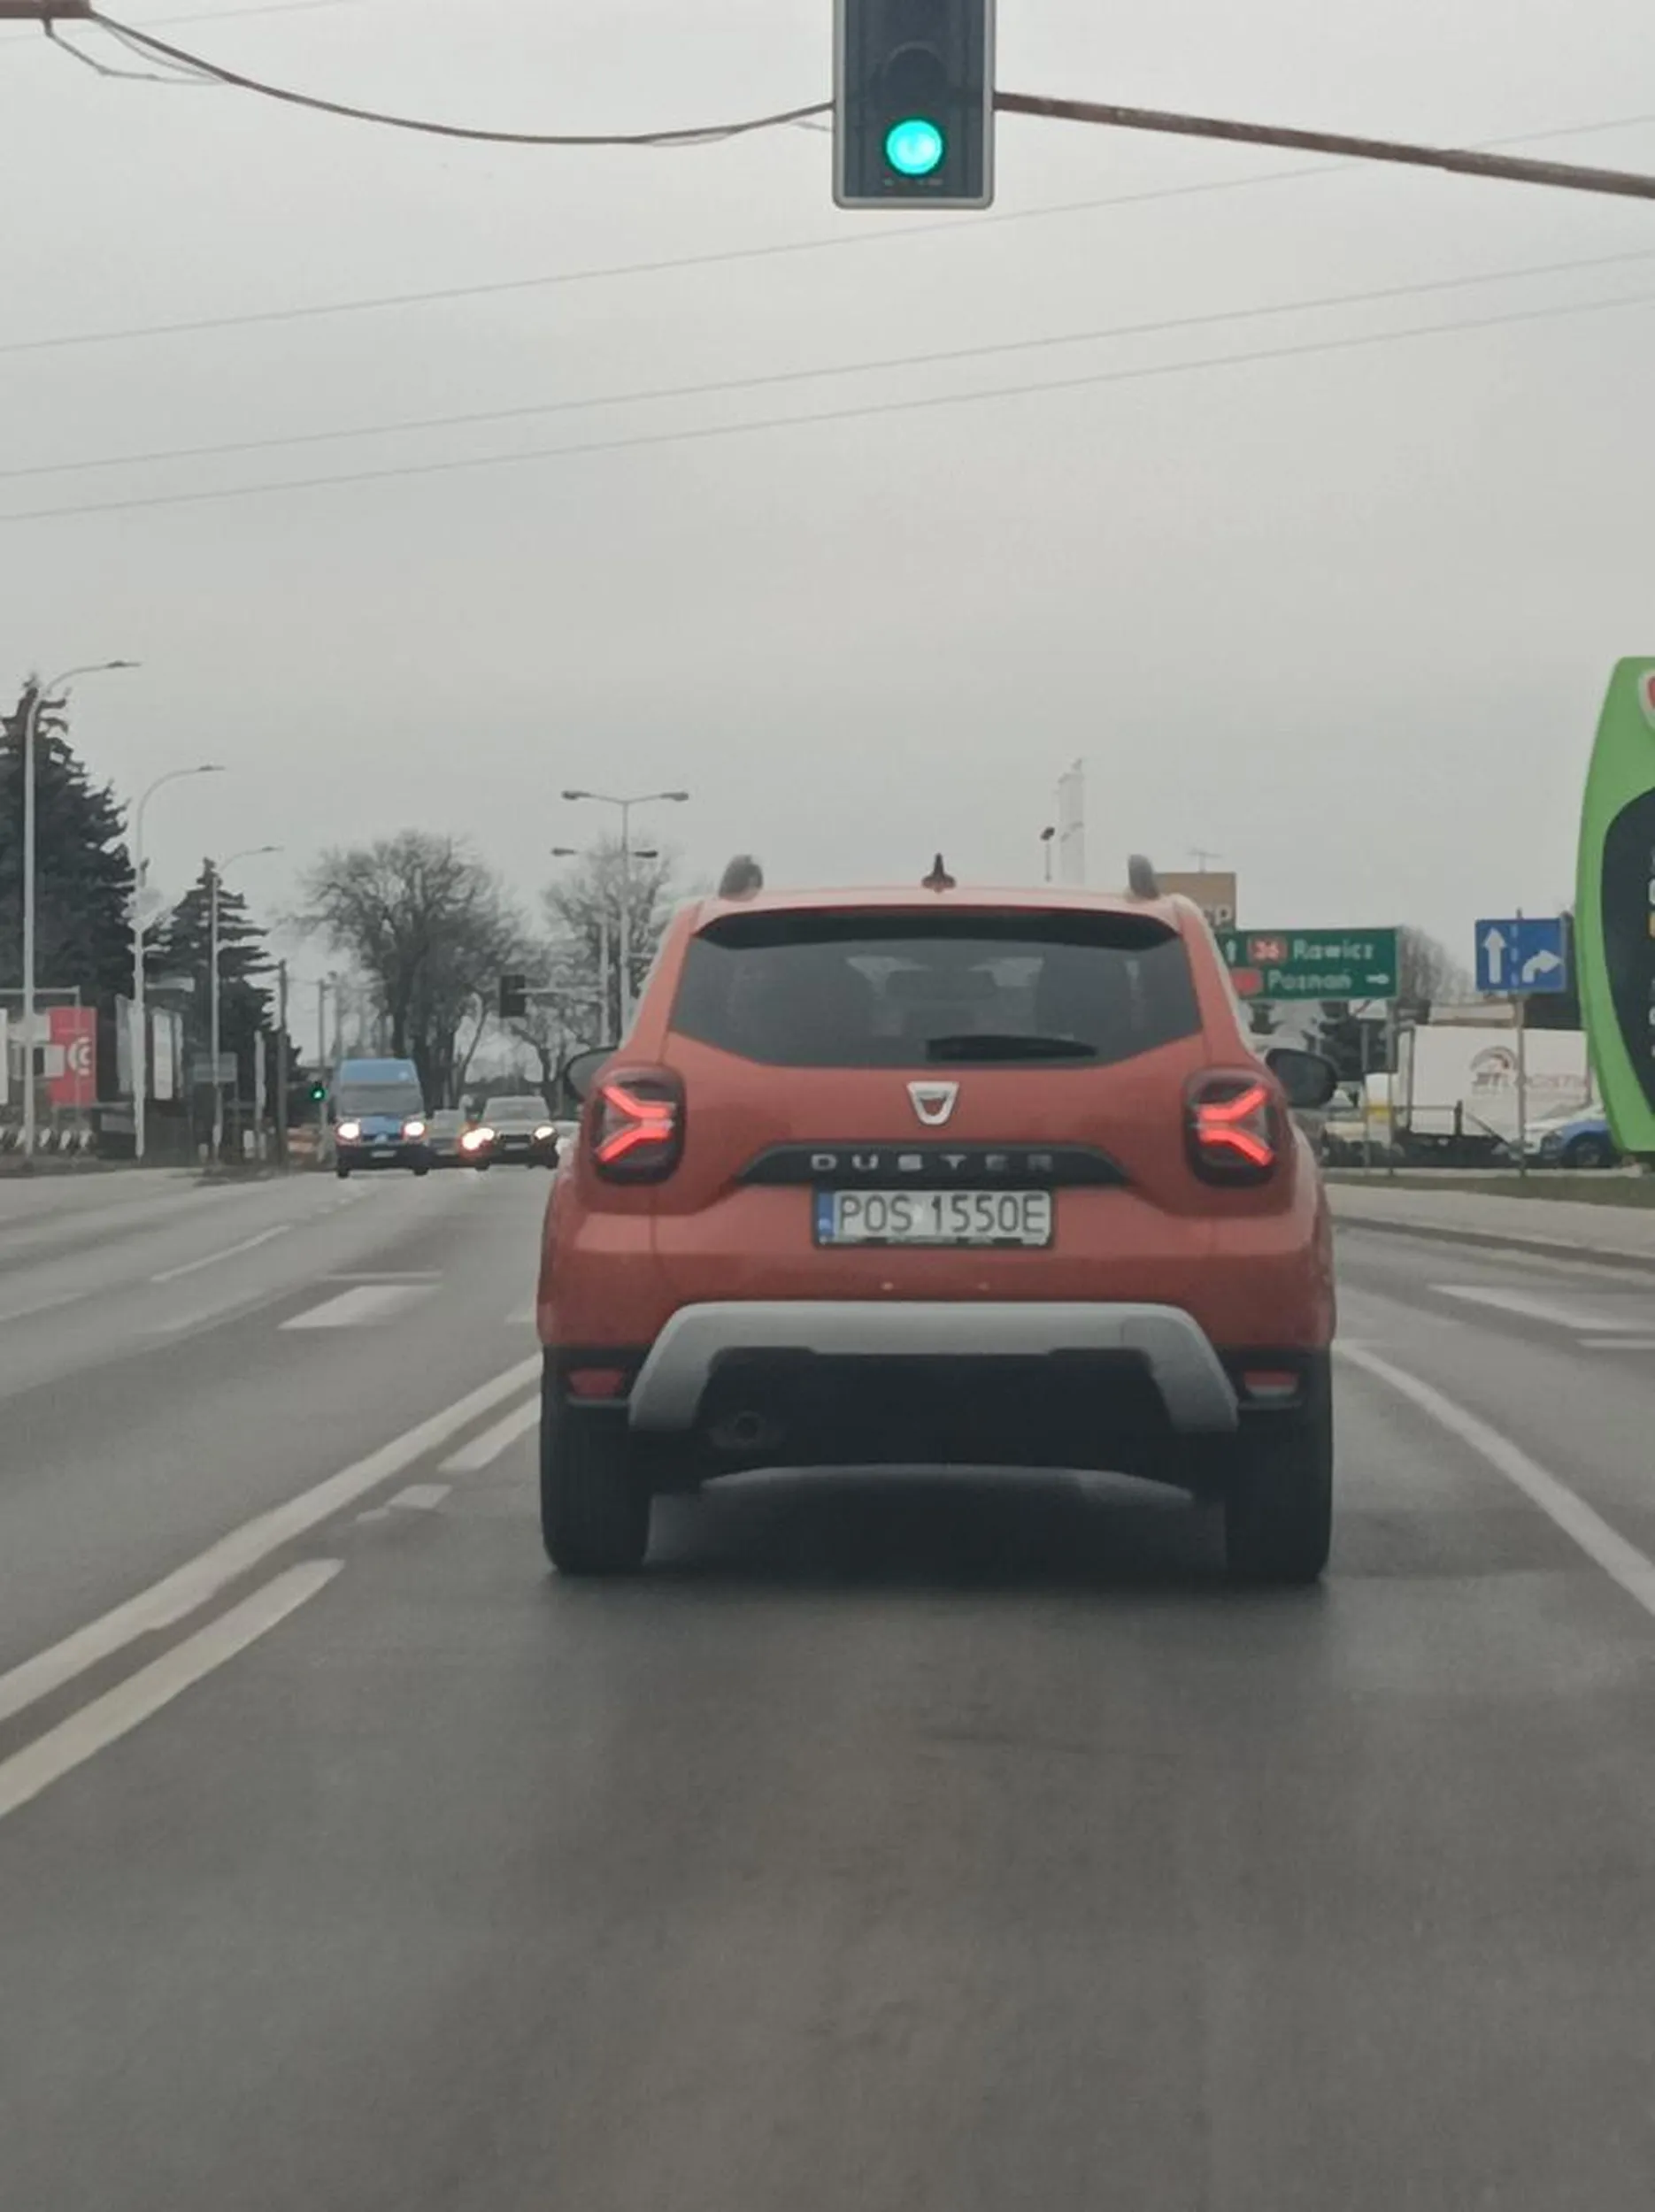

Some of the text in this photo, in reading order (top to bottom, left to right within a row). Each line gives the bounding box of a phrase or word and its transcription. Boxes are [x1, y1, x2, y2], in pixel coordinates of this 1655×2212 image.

[1293, 938, 1374, 960] Rawicz
[811, 1153, 1053, 1171] DUSTER
[840, 1194, 1047, 1233] POS 1550E
